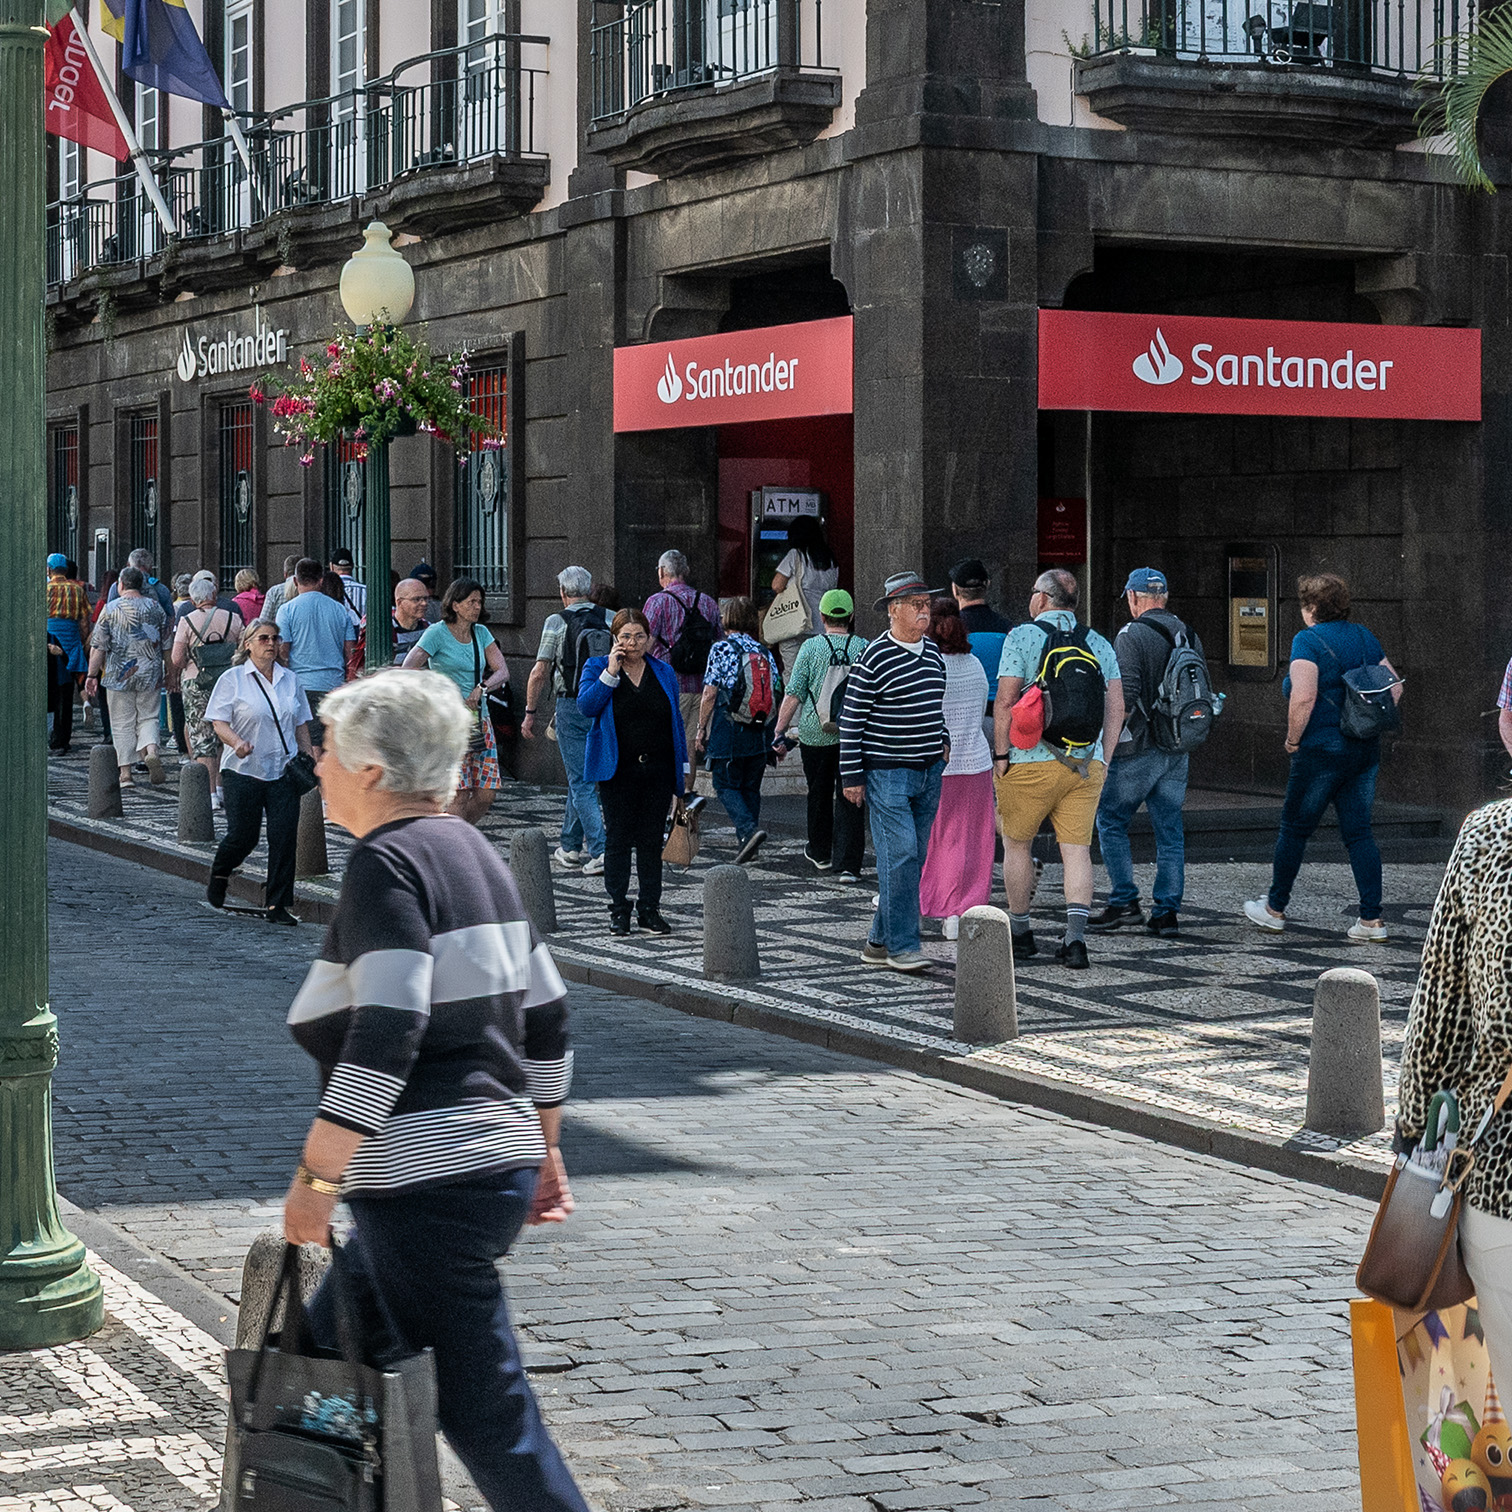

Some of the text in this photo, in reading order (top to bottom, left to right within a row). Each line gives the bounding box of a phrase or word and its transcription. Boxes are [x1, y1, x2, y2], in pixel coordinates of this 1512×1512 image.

[197, 325, 286, 377] Santander
[1191, 344, 1393, 392] Santander
[686, 352, 799, 401] Santander
[766, 499, 800, 513] ATM
